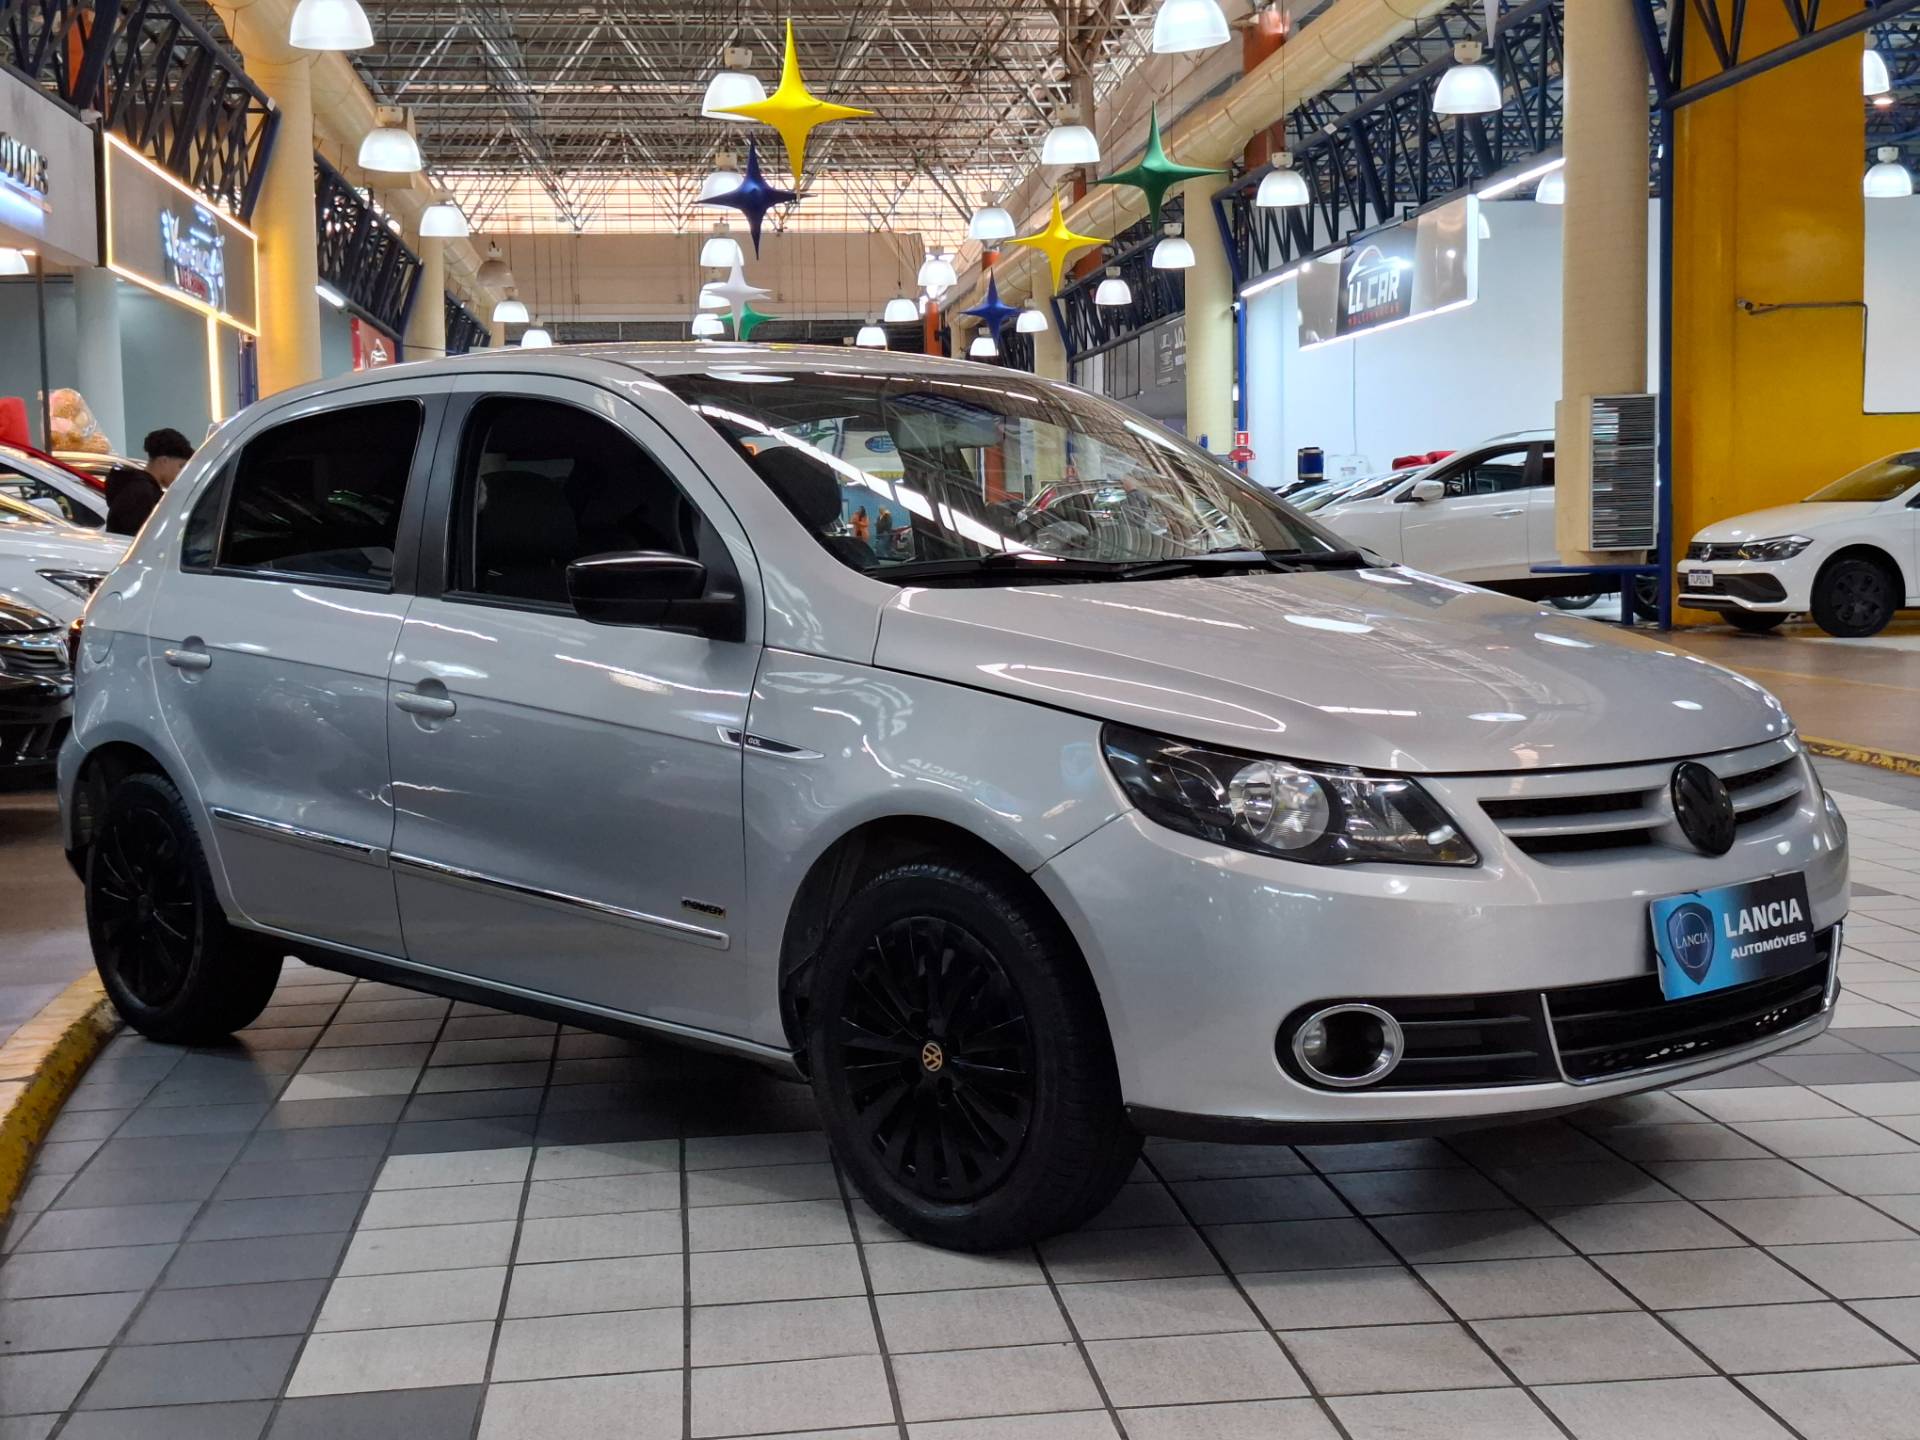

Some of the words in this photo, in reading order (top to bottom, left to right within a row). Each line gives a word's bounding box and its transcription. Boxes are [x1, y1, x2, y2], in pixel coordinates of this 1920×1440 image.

[1367, 270, 1400, 308] CAR
[1723, 897, 1803, 938] LANCIA
[1675, 932, 1710, 949] LANCIA
[1731, 931, 1807, 959] AUTOMÓVEIS
